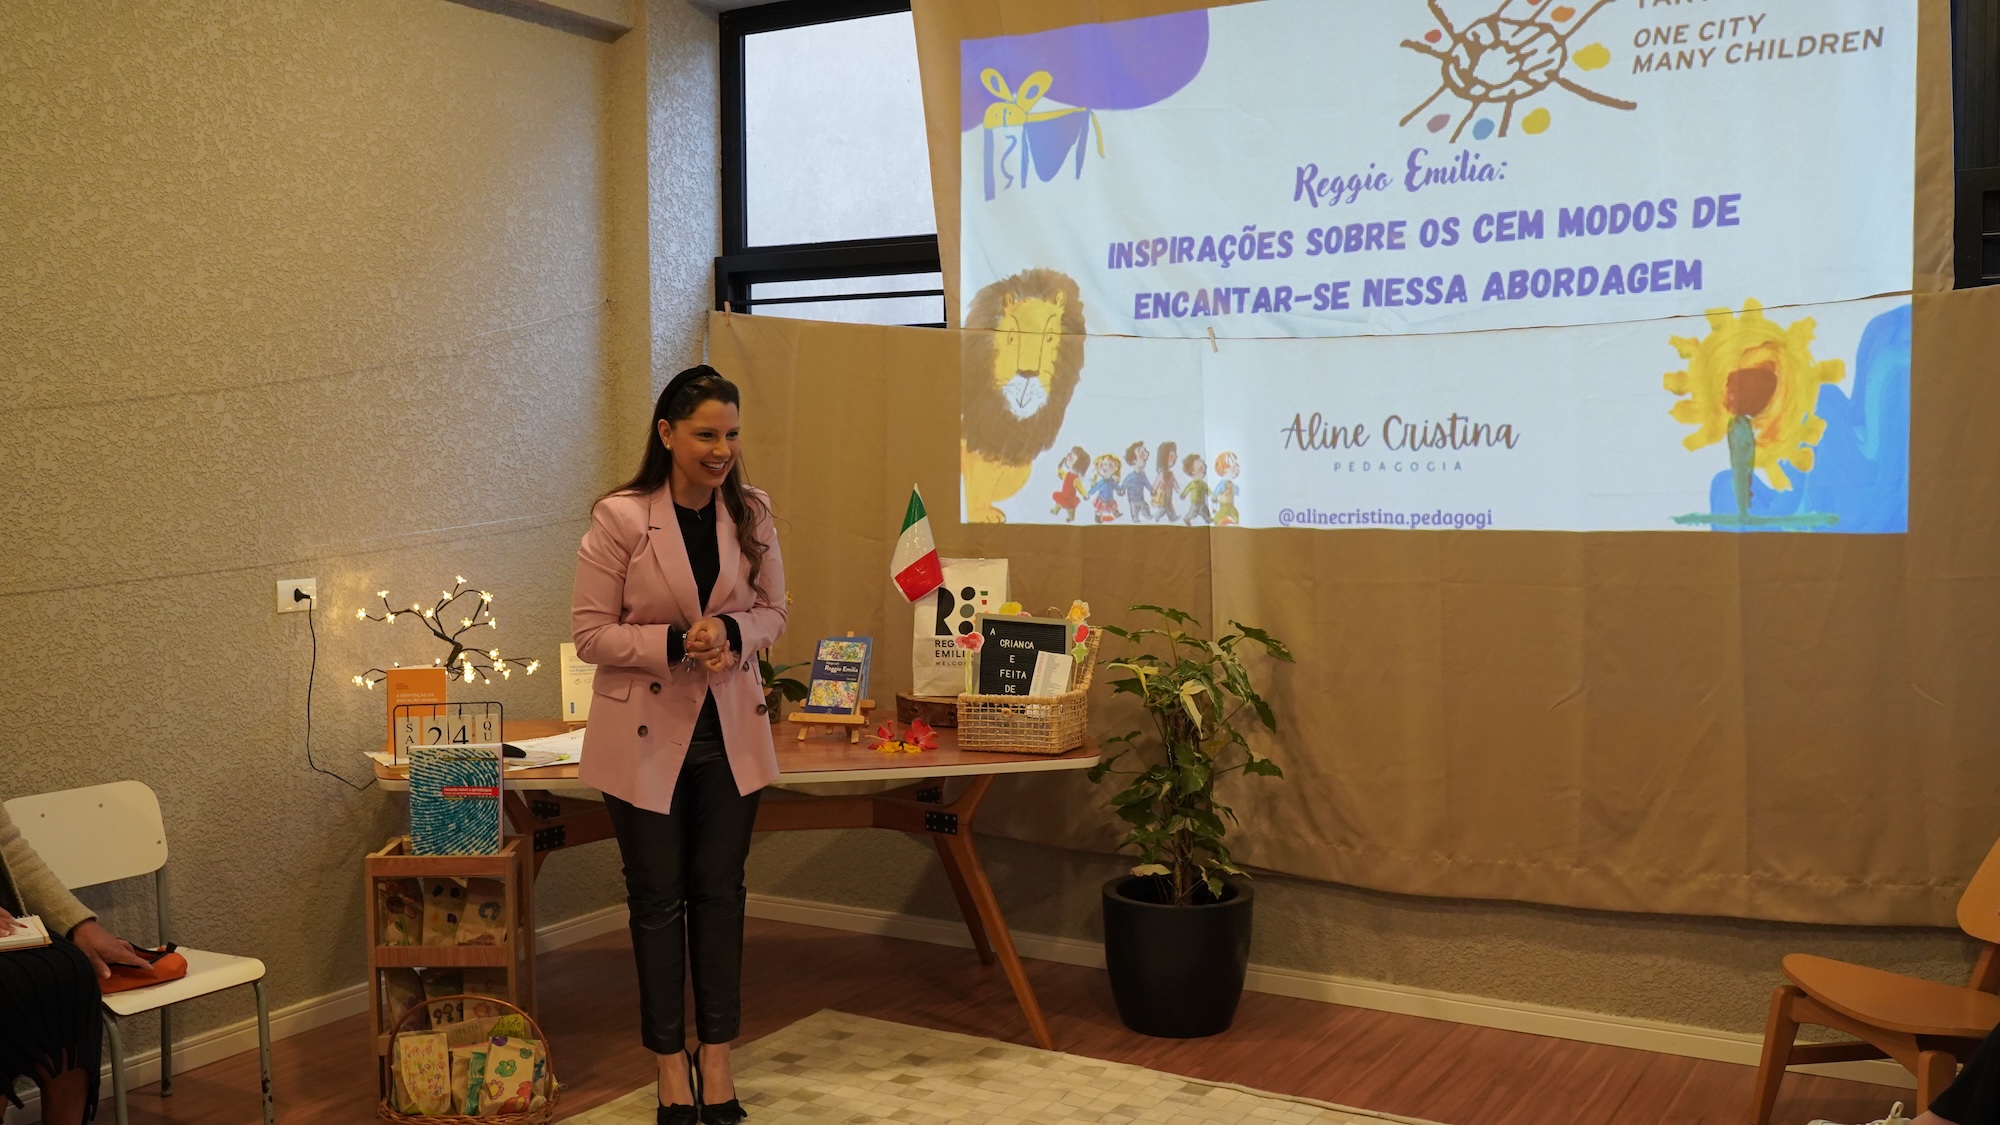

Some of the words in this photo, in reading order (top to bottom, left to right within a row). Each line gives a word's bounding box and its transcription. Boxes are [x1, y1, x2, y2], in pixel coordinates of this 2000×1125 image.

[1633, 24, 1690, 48] ONE
[1699, 13, 1767, 42] CITY
[1632, 47, 1717, 75] MANY
[1725, 26, 1884, 64] CHILDREN
[1293, 163, 1393, 208] Reggio
[1403, 147, 1508, 193] Emilia:
[1107, 224, 1294, 270] INSPIRAÇÕES
[1305, 220, 1408, 256] SOBRE
[1419, 216, 1461, 249] OS
[1472, 208, 1545, 244] CEM
[1557, 198, 1678, 238] MODOS
[1692, 193, 1742, 229] DE
[1133, 281, 1351, 320] ENCANTAR-SE
[1362, 274, 1468, 308] NESSA
[1481, 259, 1703, 302] ABORDAGEM
[1280, 411, 1371, 451] Aline
[1382, 412, 1520, 451] Cristina
[1333, 461, 1463, 473] PEDAGOGIA
[1278, 508, 1493, 530] @alinecristina.pedagogi
[989, 627, 996, 636] A
[999, 639, 1035, 649] CRIANCA
[935, 650, 974, 658] EMILI
[1009, 654, 1016, 664] E
[999, 669, 1027, 680] FEITA
[1004, 684, 1016, 694] DE
